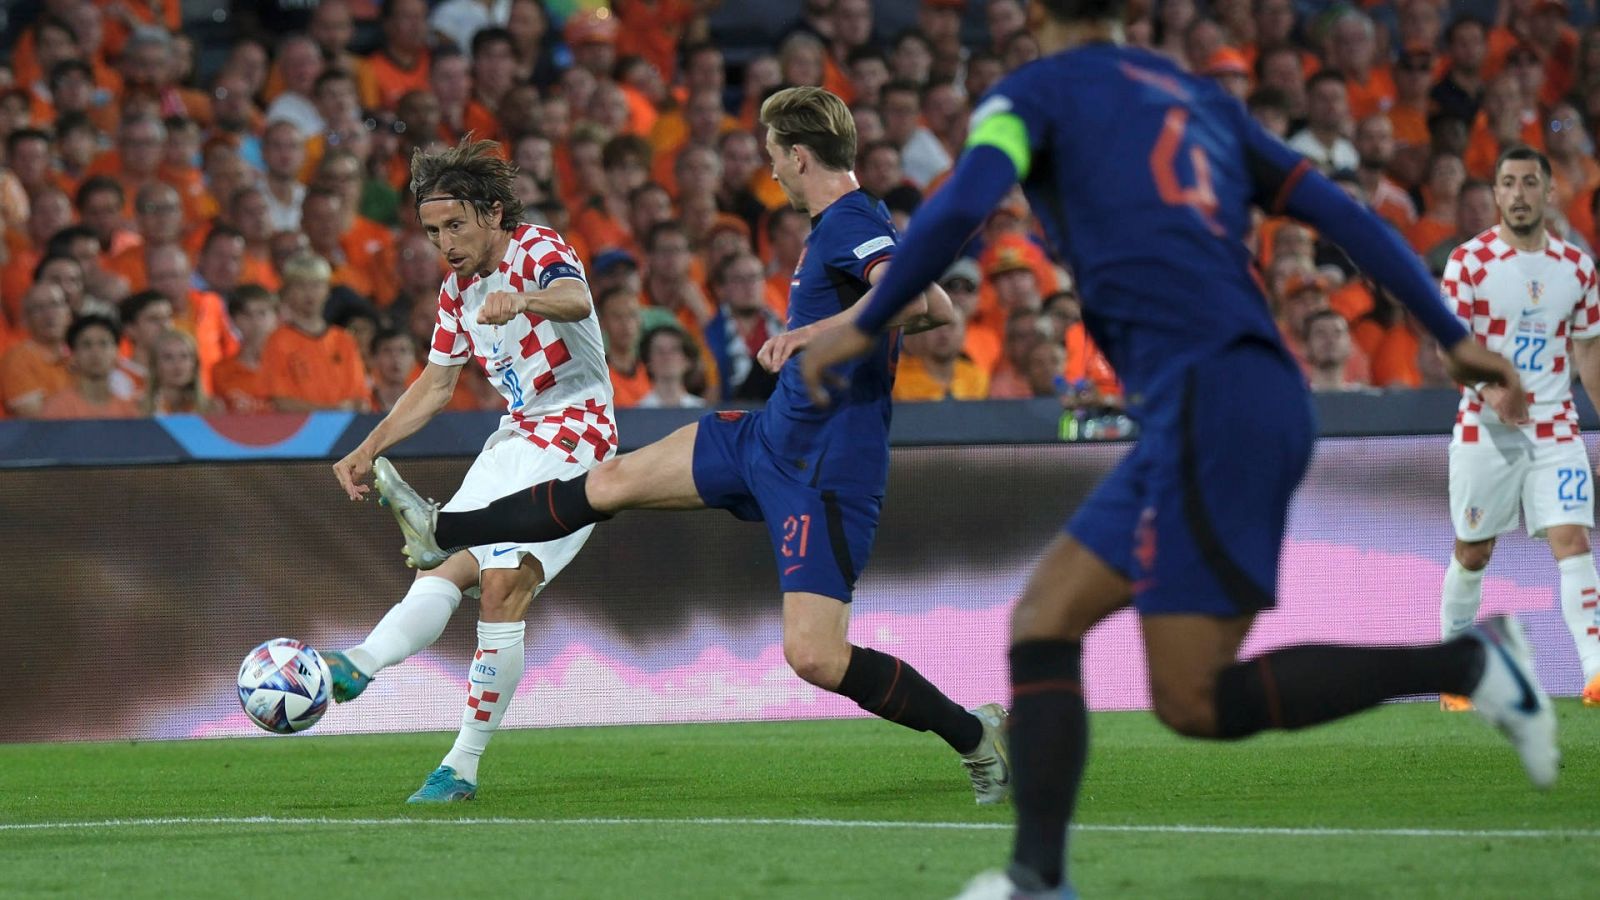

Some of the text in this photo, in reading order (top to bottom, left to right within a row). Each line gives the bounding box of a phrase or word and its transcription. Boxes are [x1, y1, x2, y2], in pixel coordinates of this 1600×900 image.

[1149, 105, 1220, 220] 4
[1513, 336, 1546, 370] 22
[502, 368, 524, 409] 10
[1557, 469, 1588, 502] 22
[780, 514, 811, 558] 21
